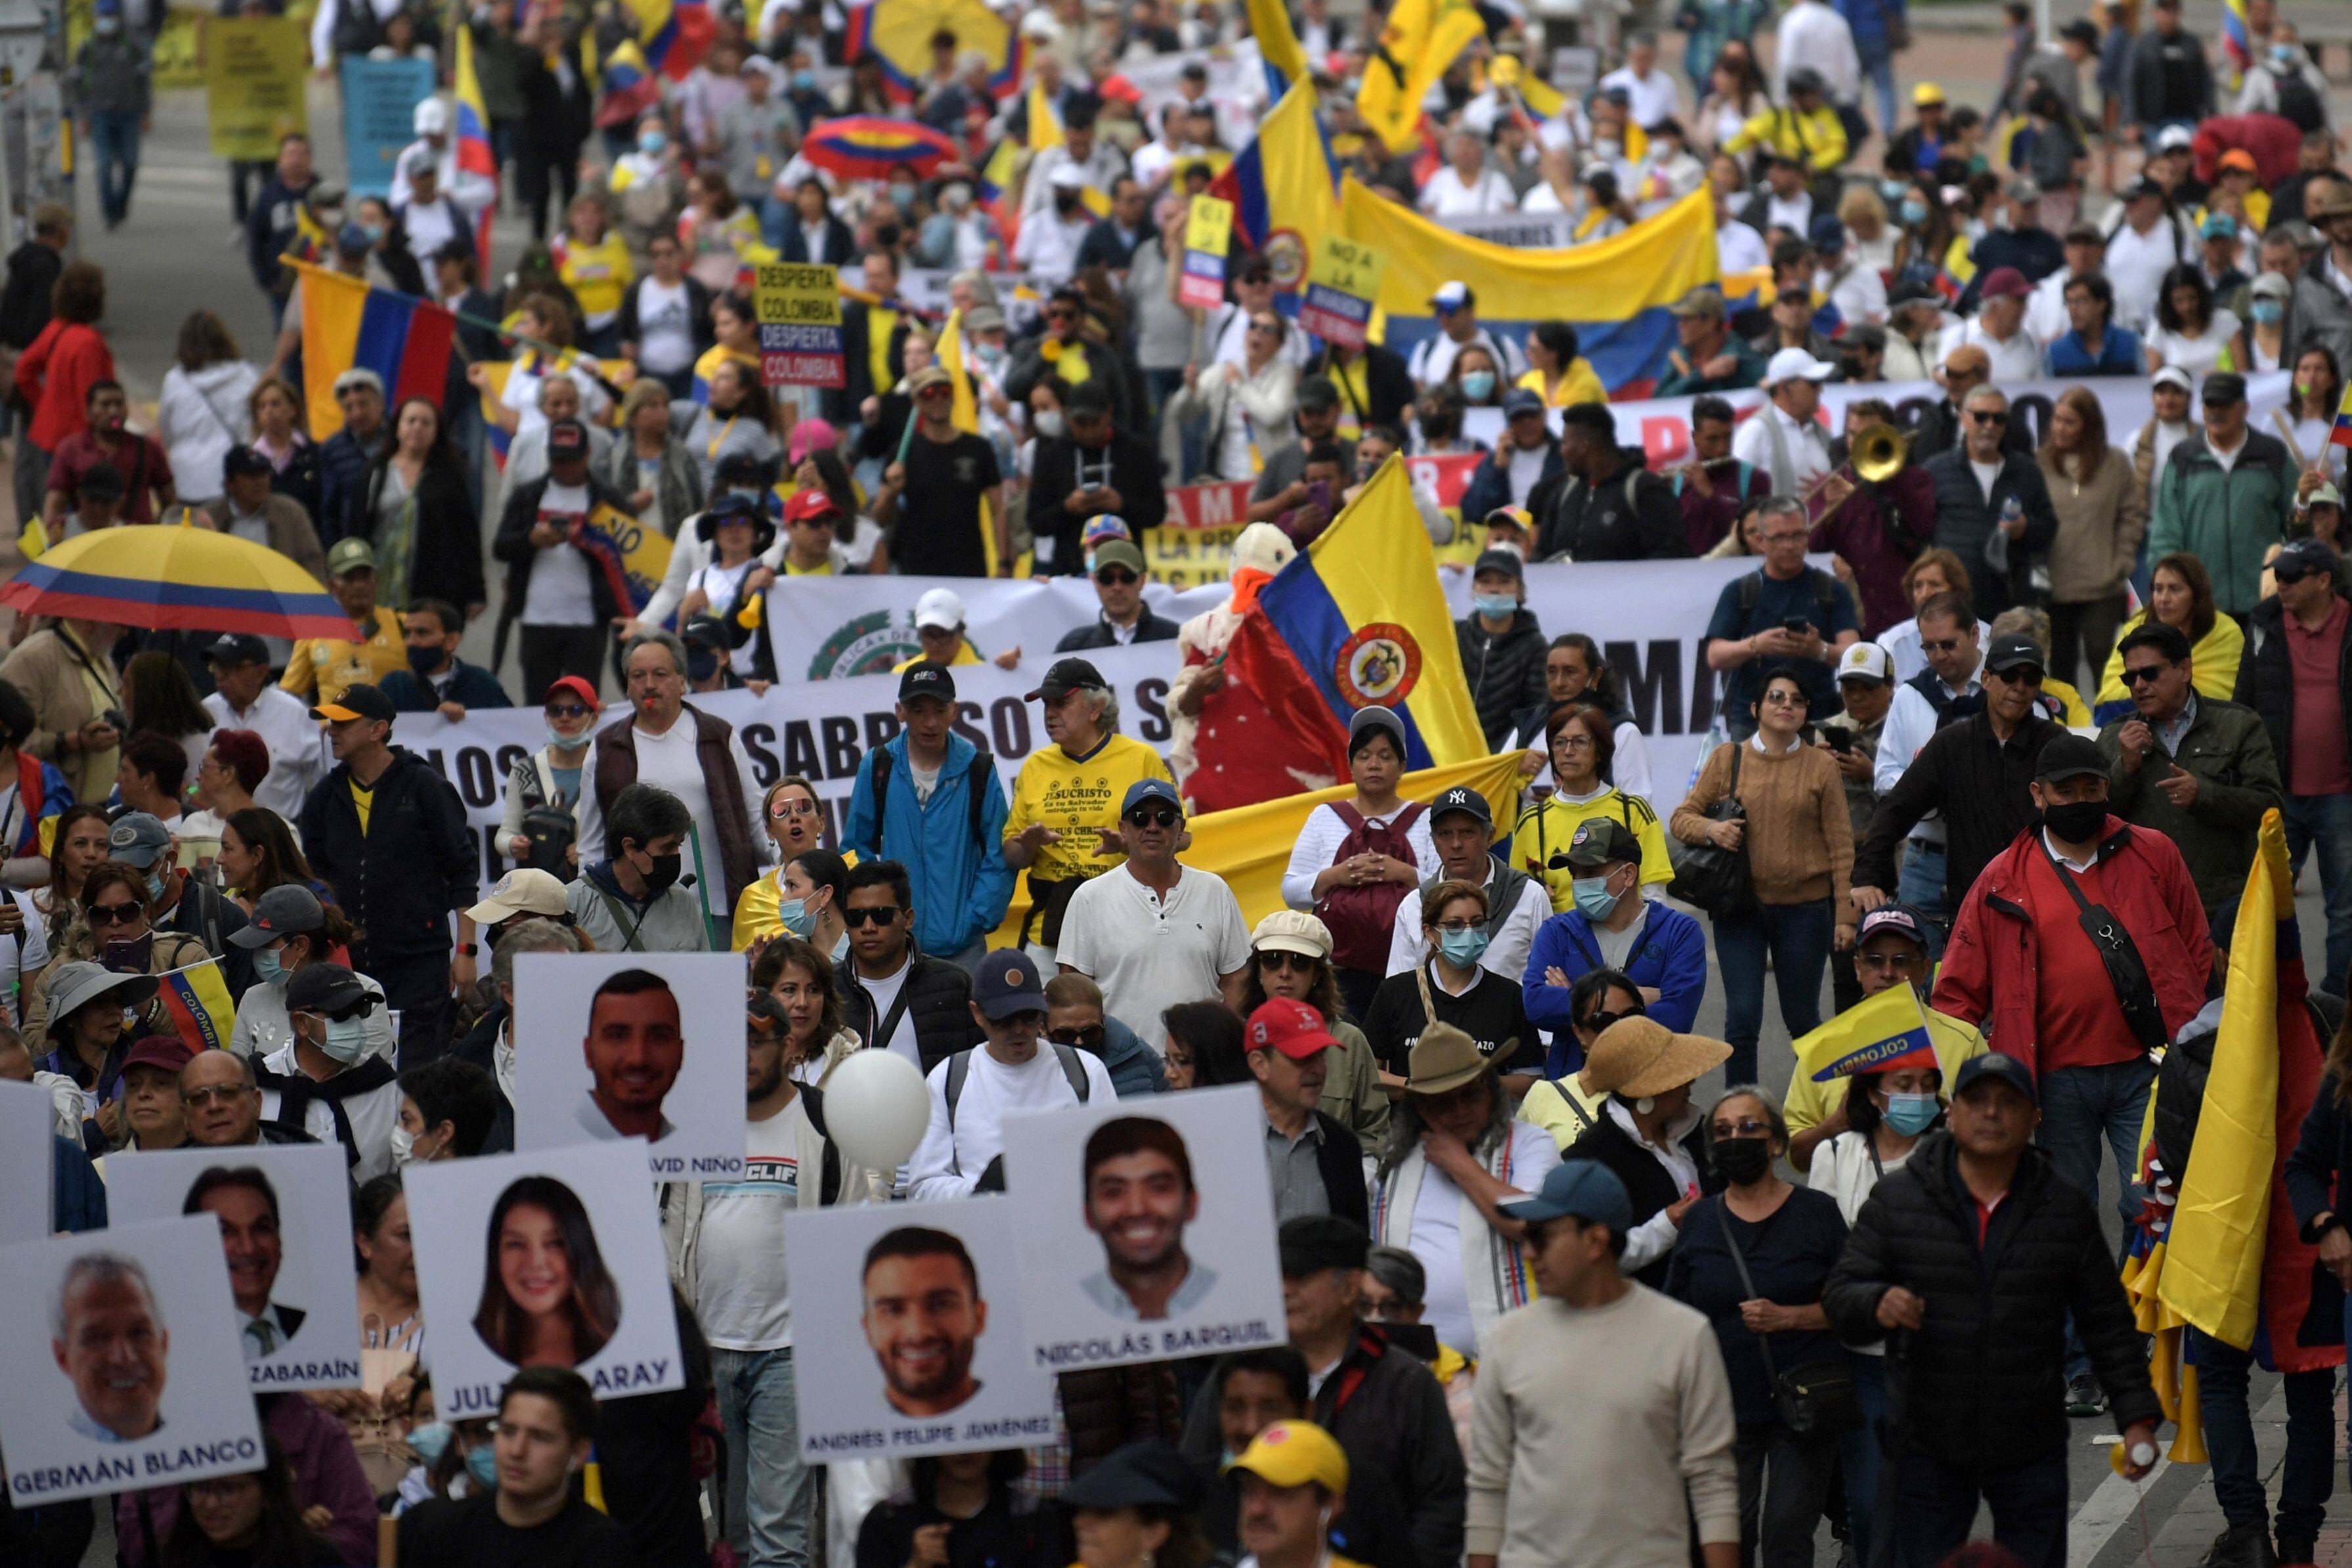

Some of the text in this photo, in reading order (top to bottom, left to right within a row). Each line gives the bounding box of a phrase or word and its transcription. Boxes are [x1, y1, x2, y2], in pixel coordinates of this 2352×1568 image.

[760, 267, 833, 289] DESPIERTA
[763, 297, 835, 320] COLOMBIA
[762, 324, 838, 349] DESPIERTA
[766, 356, 838, 380] COLOMBIA
[740, 697, 1032, 789] SABRSO
[1043, 789, 1112, 801] JESUCRISTO
[1448, 790, 1466, 804] NY
[1252, 1022, 1267, 1043] 3
[649, 1154, 742, 1173] VID NIÑO
[1035, 1332, 1154, 1366] NICOLÁS
[250, 1359, 360, 1383] ZABARAÍN
[449, 1382, 510, 1412] JUL
[807, 1415, 1051, 1452] ANDRÉS FELIPE JIMÉNEZ
[13, 1438, 257, 1495] GERMÁN BLANCO
